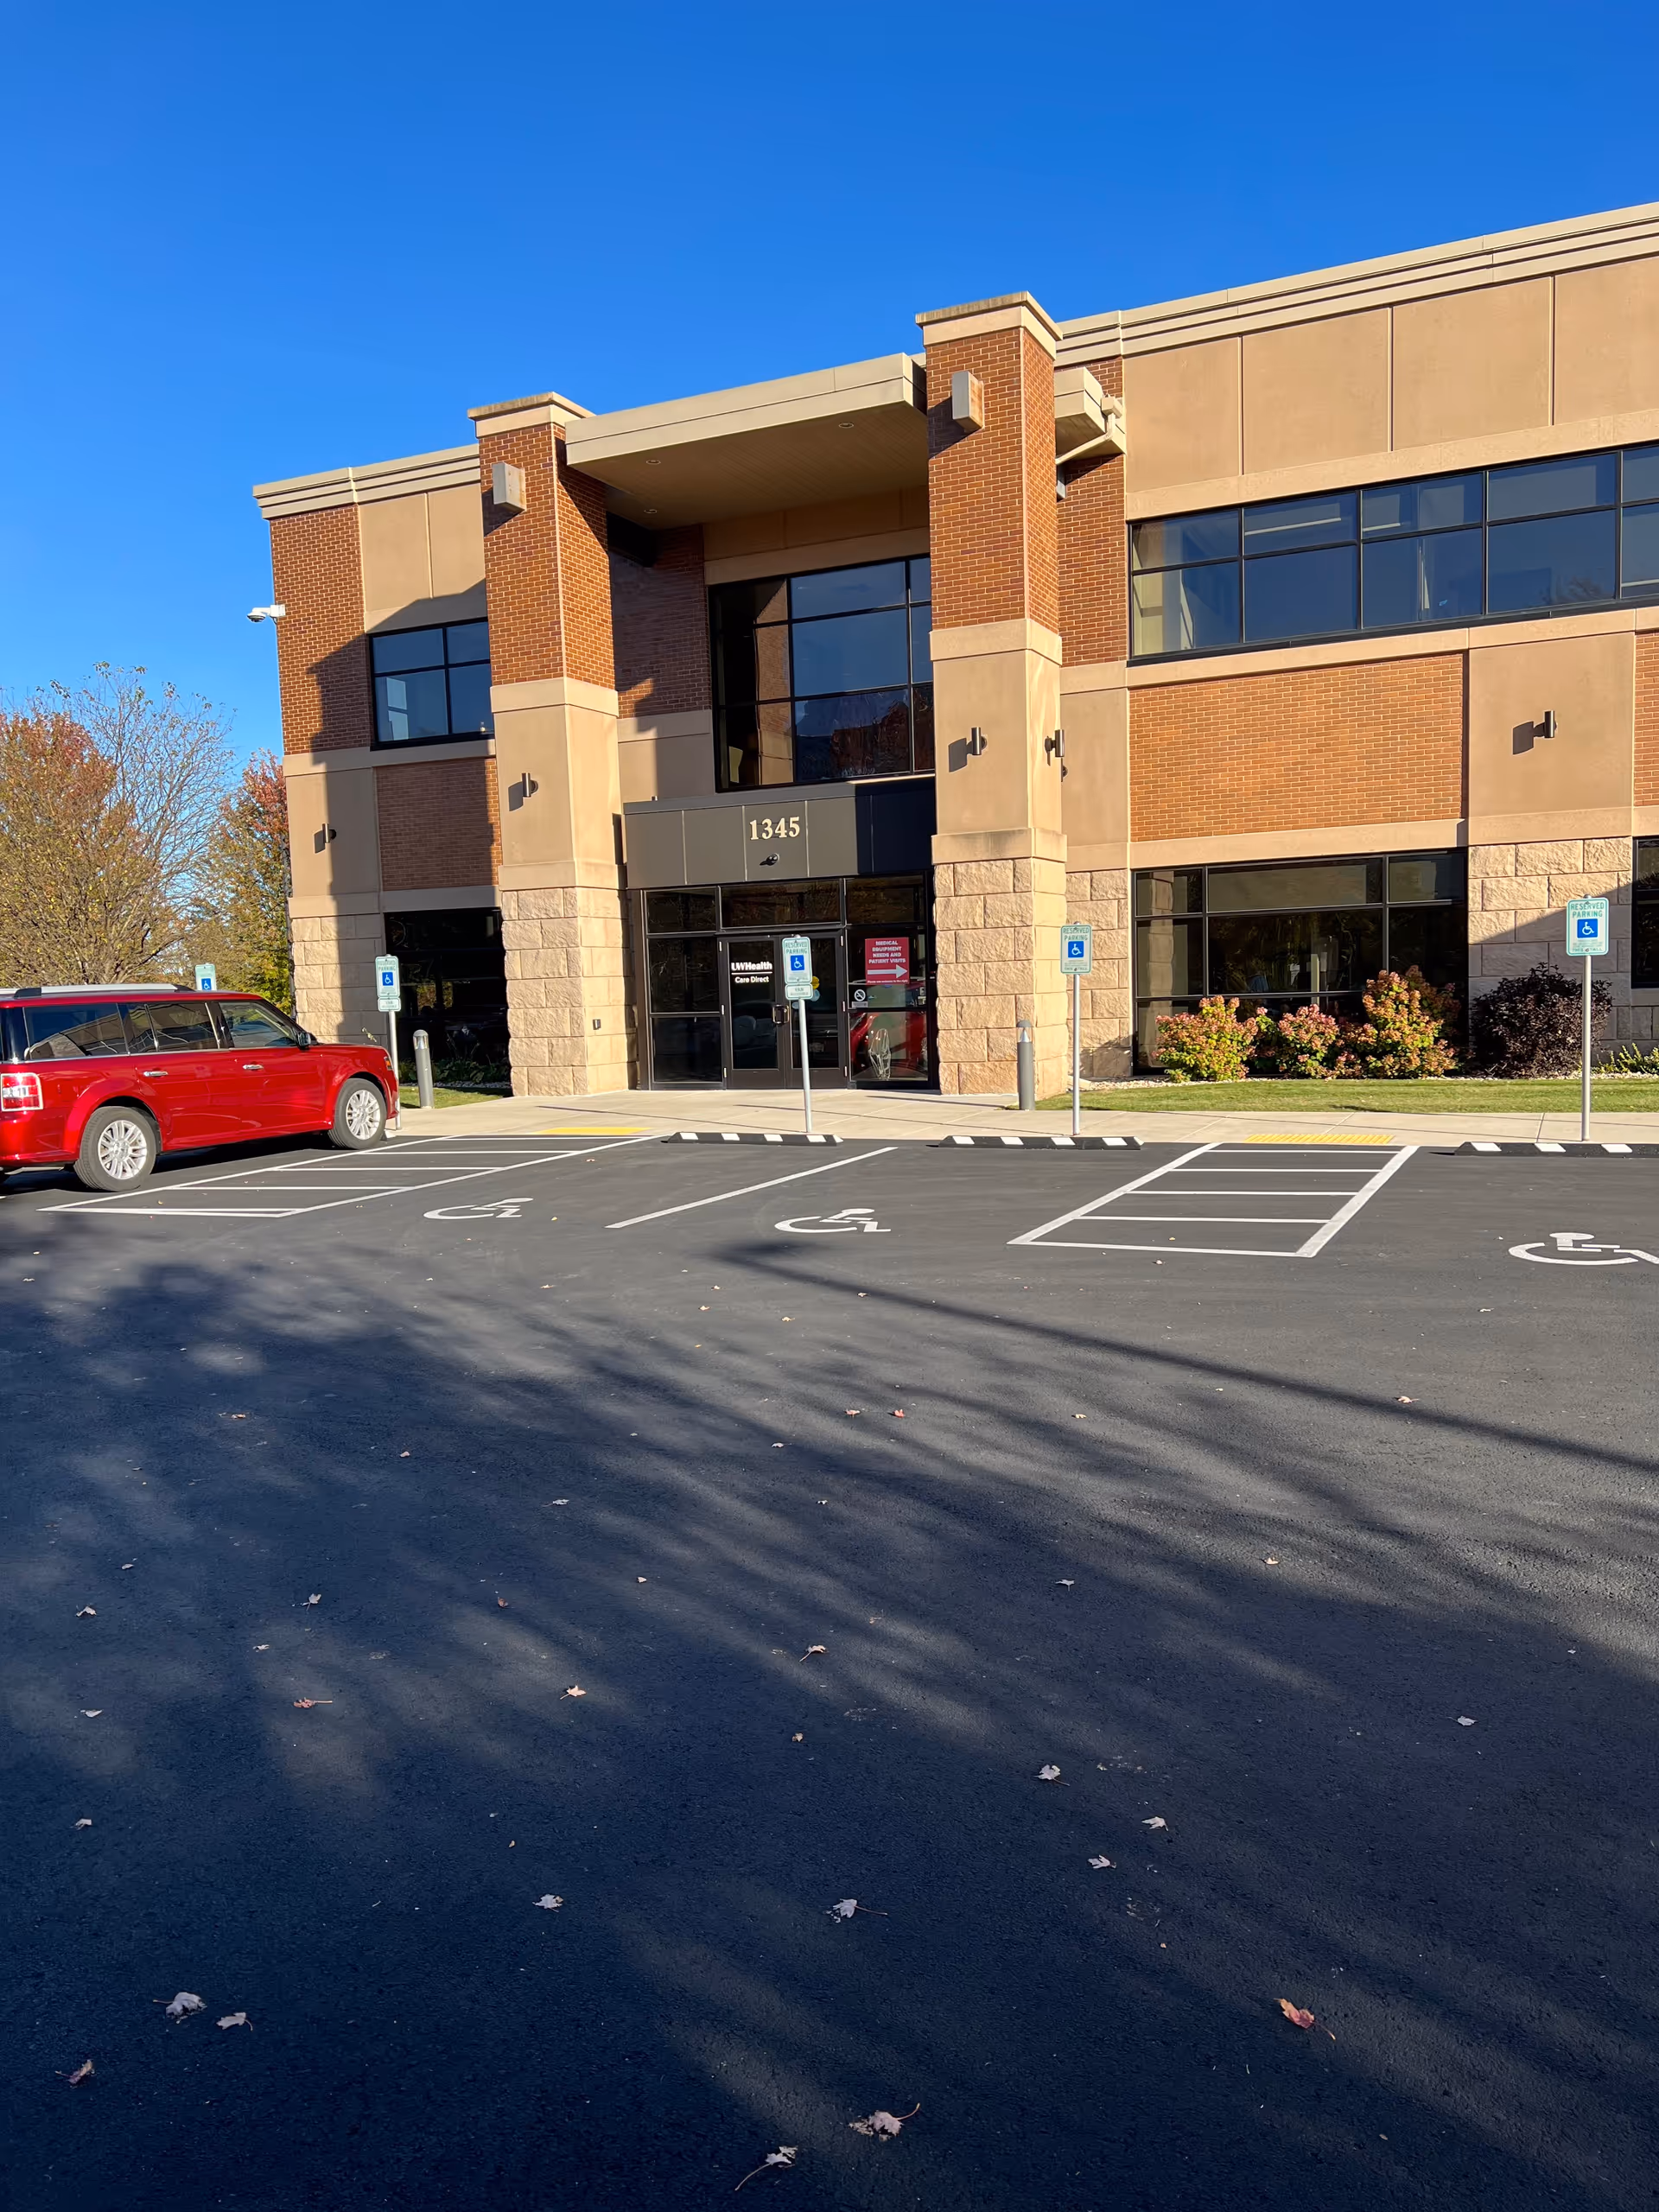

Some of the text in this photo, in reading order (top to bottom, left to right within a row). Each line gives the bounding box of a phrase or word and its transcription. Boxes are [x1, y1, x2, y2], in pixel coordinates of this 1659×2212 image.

[749, 816, 800, 841] 1345
[1571, 902, 1605, 911] RESERVED
[1572, 910, 1603, 918] PARKING
